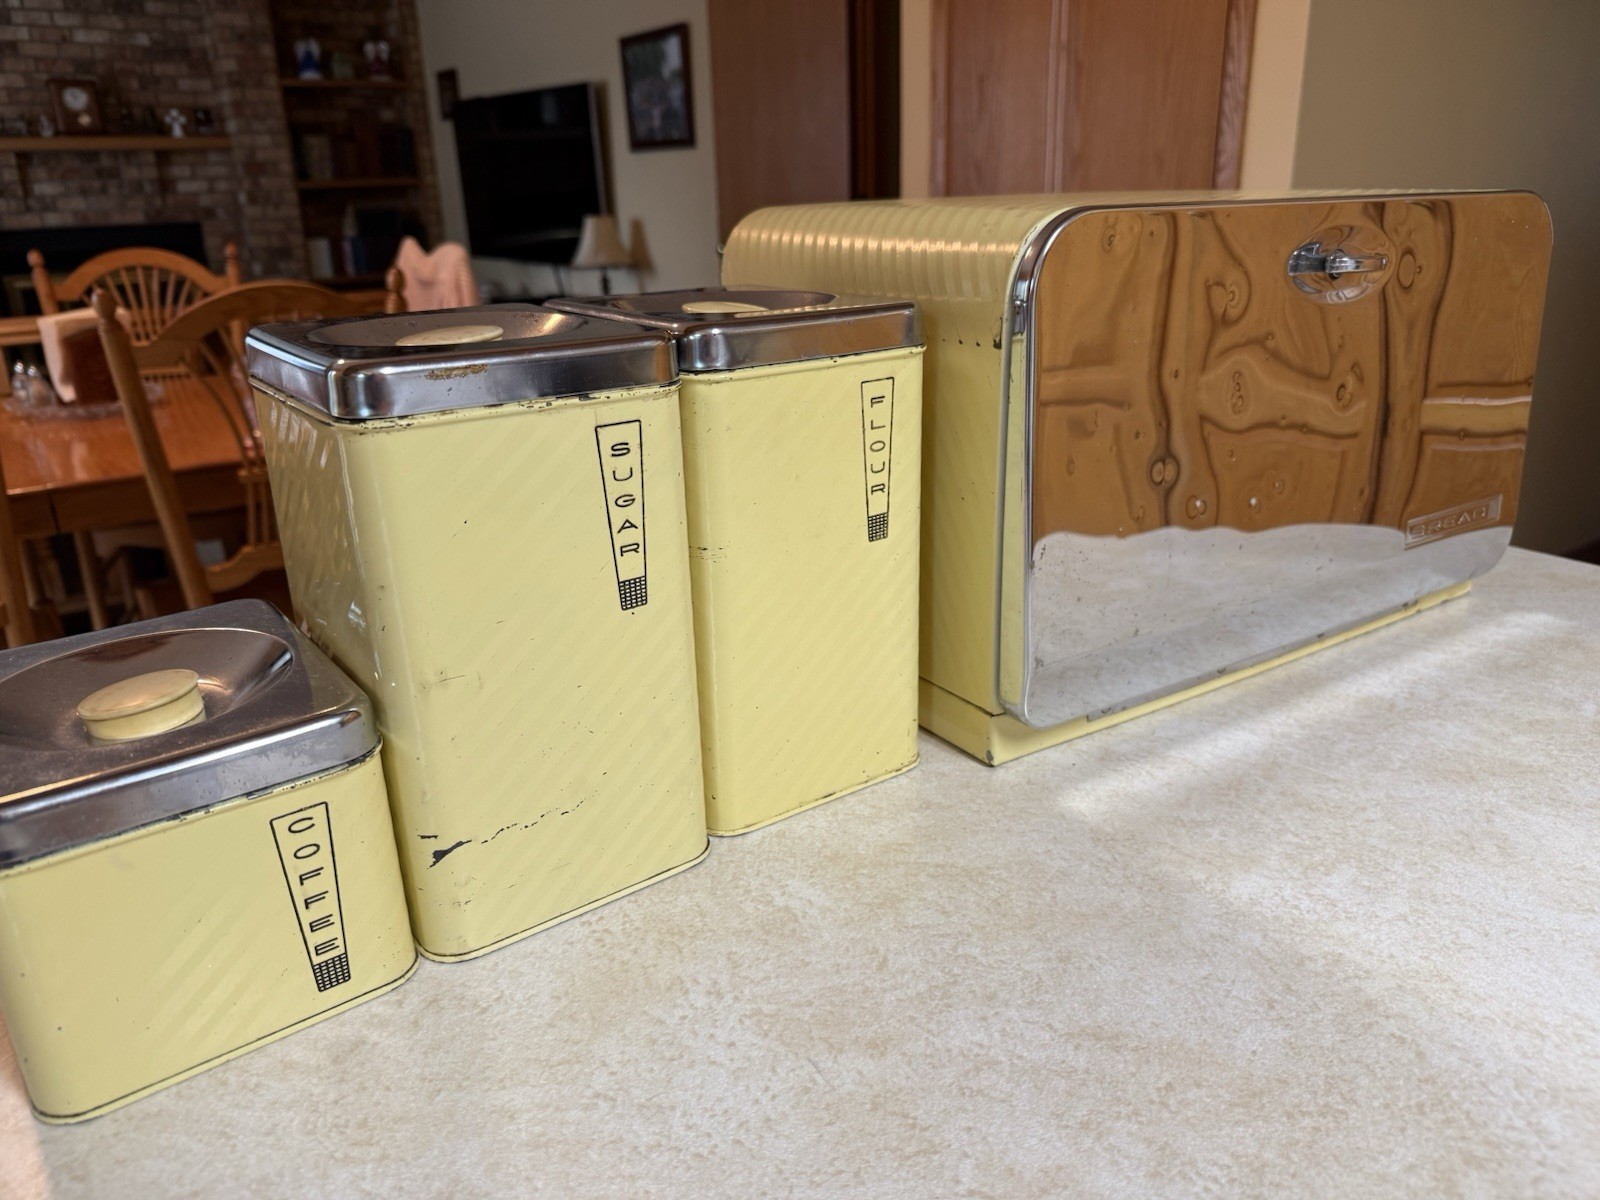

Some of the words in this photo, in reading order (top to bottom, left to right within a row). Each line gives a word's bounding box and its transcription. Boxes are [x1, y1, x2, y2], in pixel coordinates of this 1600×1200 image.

[610, 441, 641, 557] SUGAR
[869, 395, 887, 496] FLOUR
[287, 816, 340, 957] COFFEE
